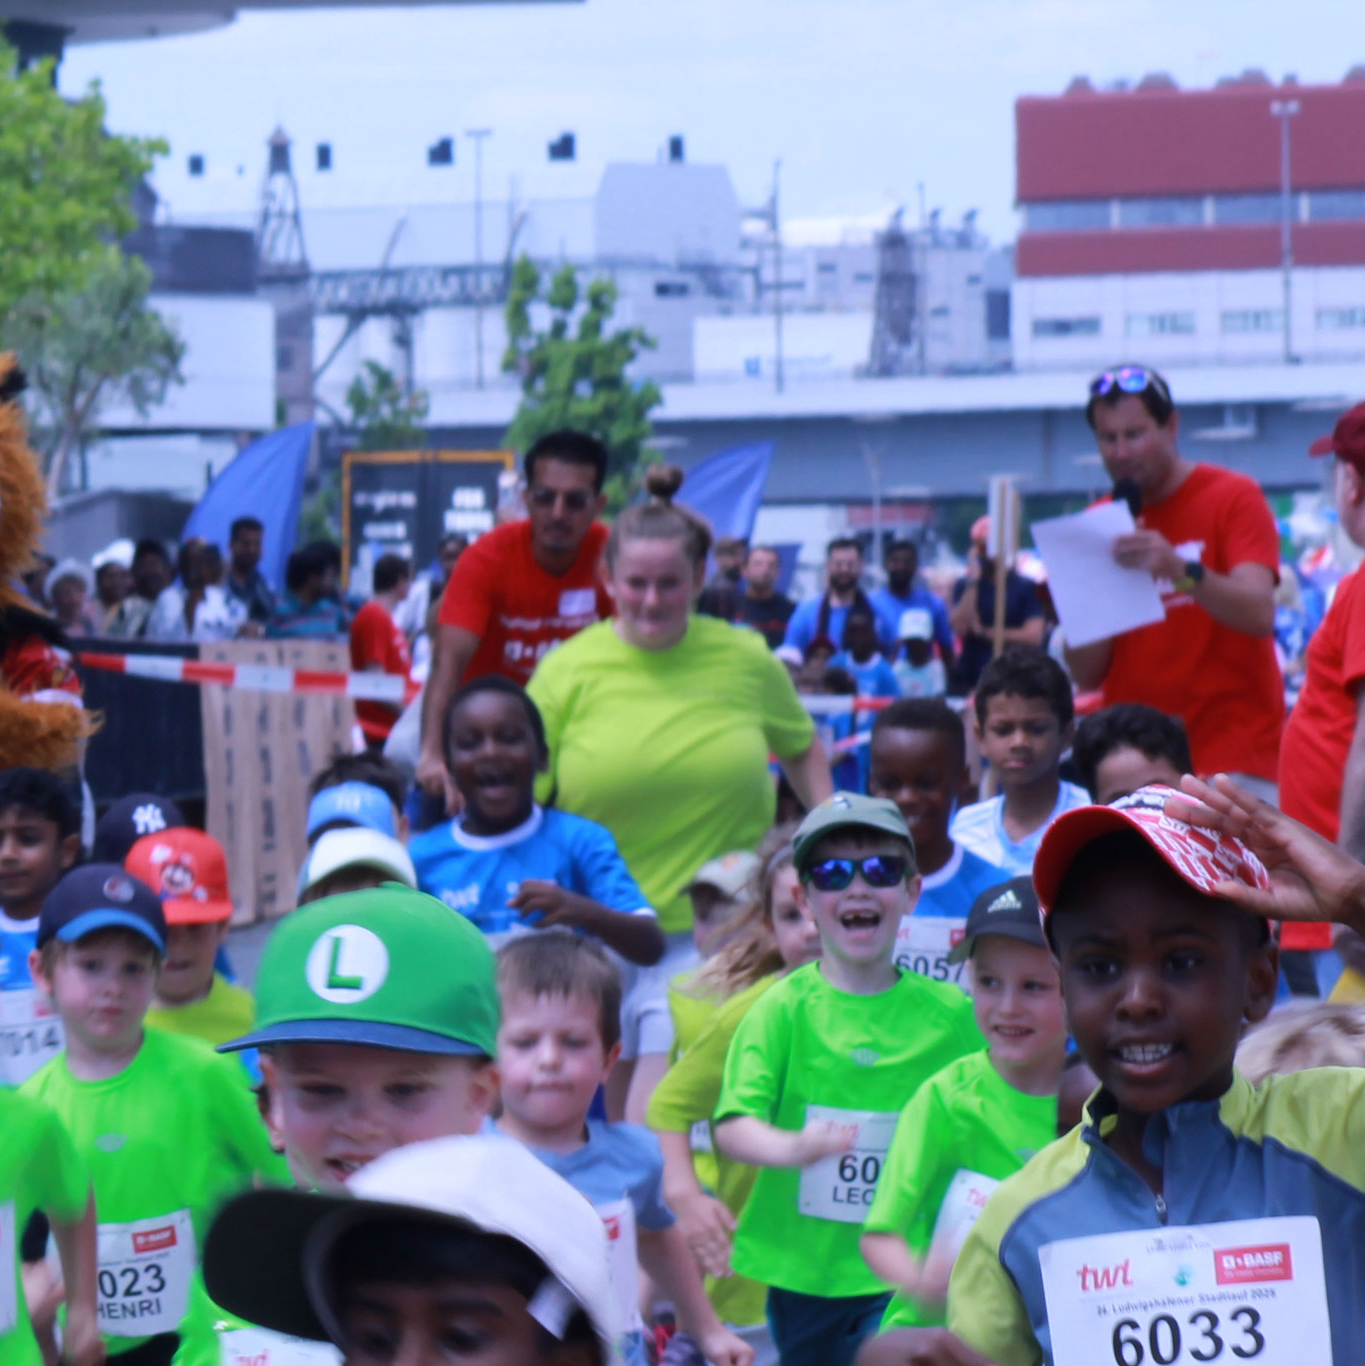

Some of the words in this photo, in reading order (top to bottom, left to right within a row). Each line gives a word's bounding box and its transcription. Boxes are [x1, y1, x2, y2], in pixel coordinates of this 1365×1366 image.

[327, 936, 363, 990] L
[837, 1154, 881, 1185] 60
[1076, 1258, 1135, 1291] twl
[1243, 1250, 1285, 1268] BASF
[98, 1262, 167, 1299] 023
